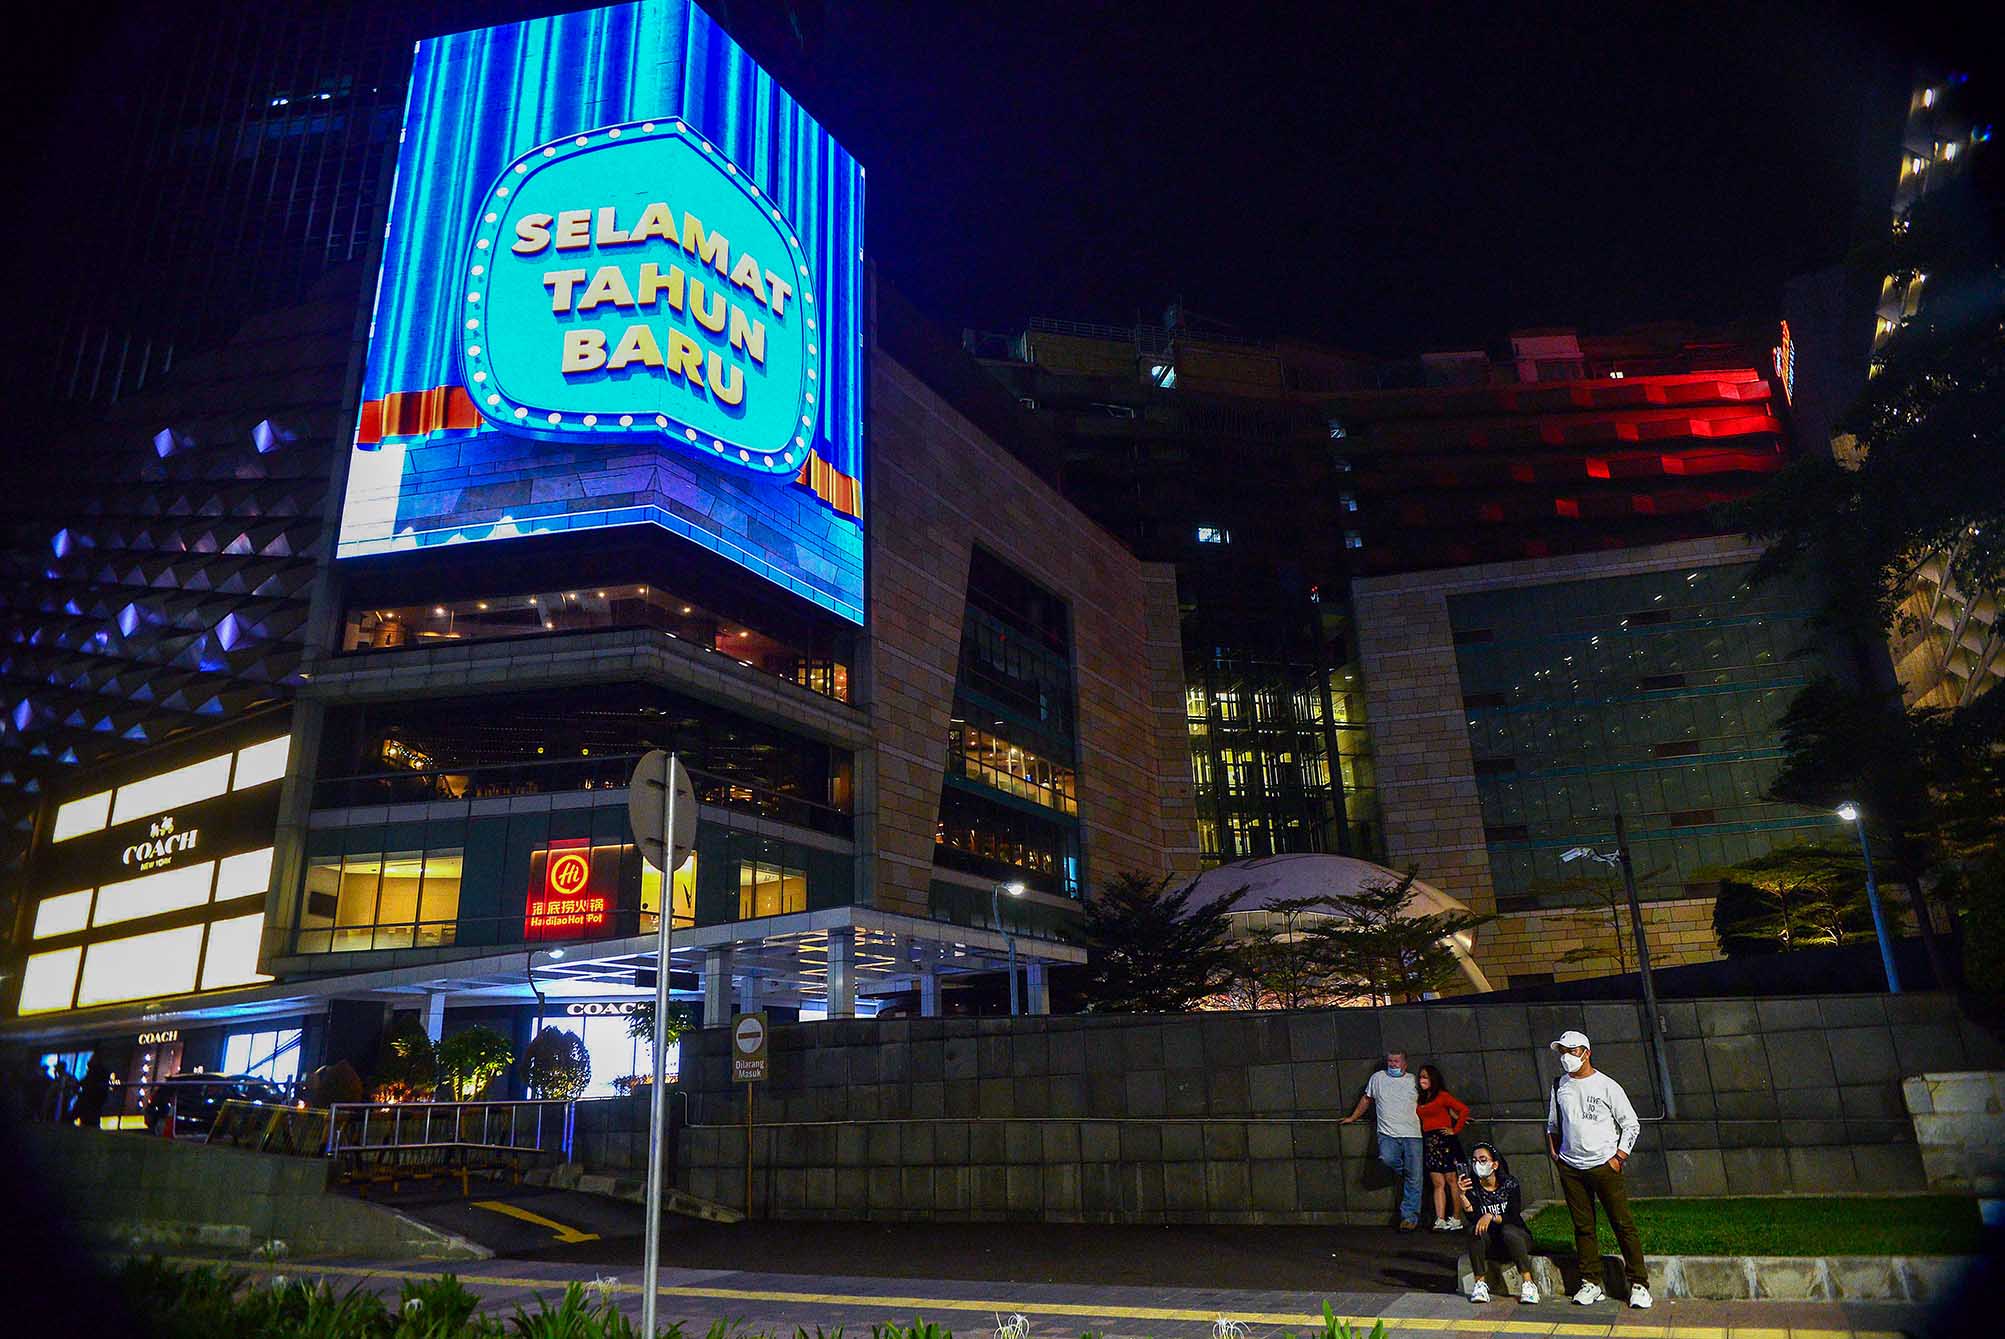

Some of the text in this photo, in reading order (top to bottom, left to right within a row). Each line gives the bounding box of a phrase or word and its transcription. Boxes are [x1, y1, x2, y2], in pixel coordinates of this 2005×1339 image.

[511, 202, 793, 316] SELAMAT
[543, 262, 765, 364] TAHUN
[561, 324, 744, 405] BARU
[122, 829, 198, 865] COACH
[558, 862, 580, 886] Hi
[532, 898, 604, 916] 海底捞火锅
[568, 914, 585, 925] Hot
[586, 913, 602, 923] Pot
[566, 1003, 647, 1016] COAC
[138, 1030, 178, 1045] COACH
[735, 1060, 765, 1070] Dilarang
[739, 1069, 761, 1079] Masuk
[1586, 1095, 1601, 1105] LIVE
[1487, 1203, 1502, 1215] THE
